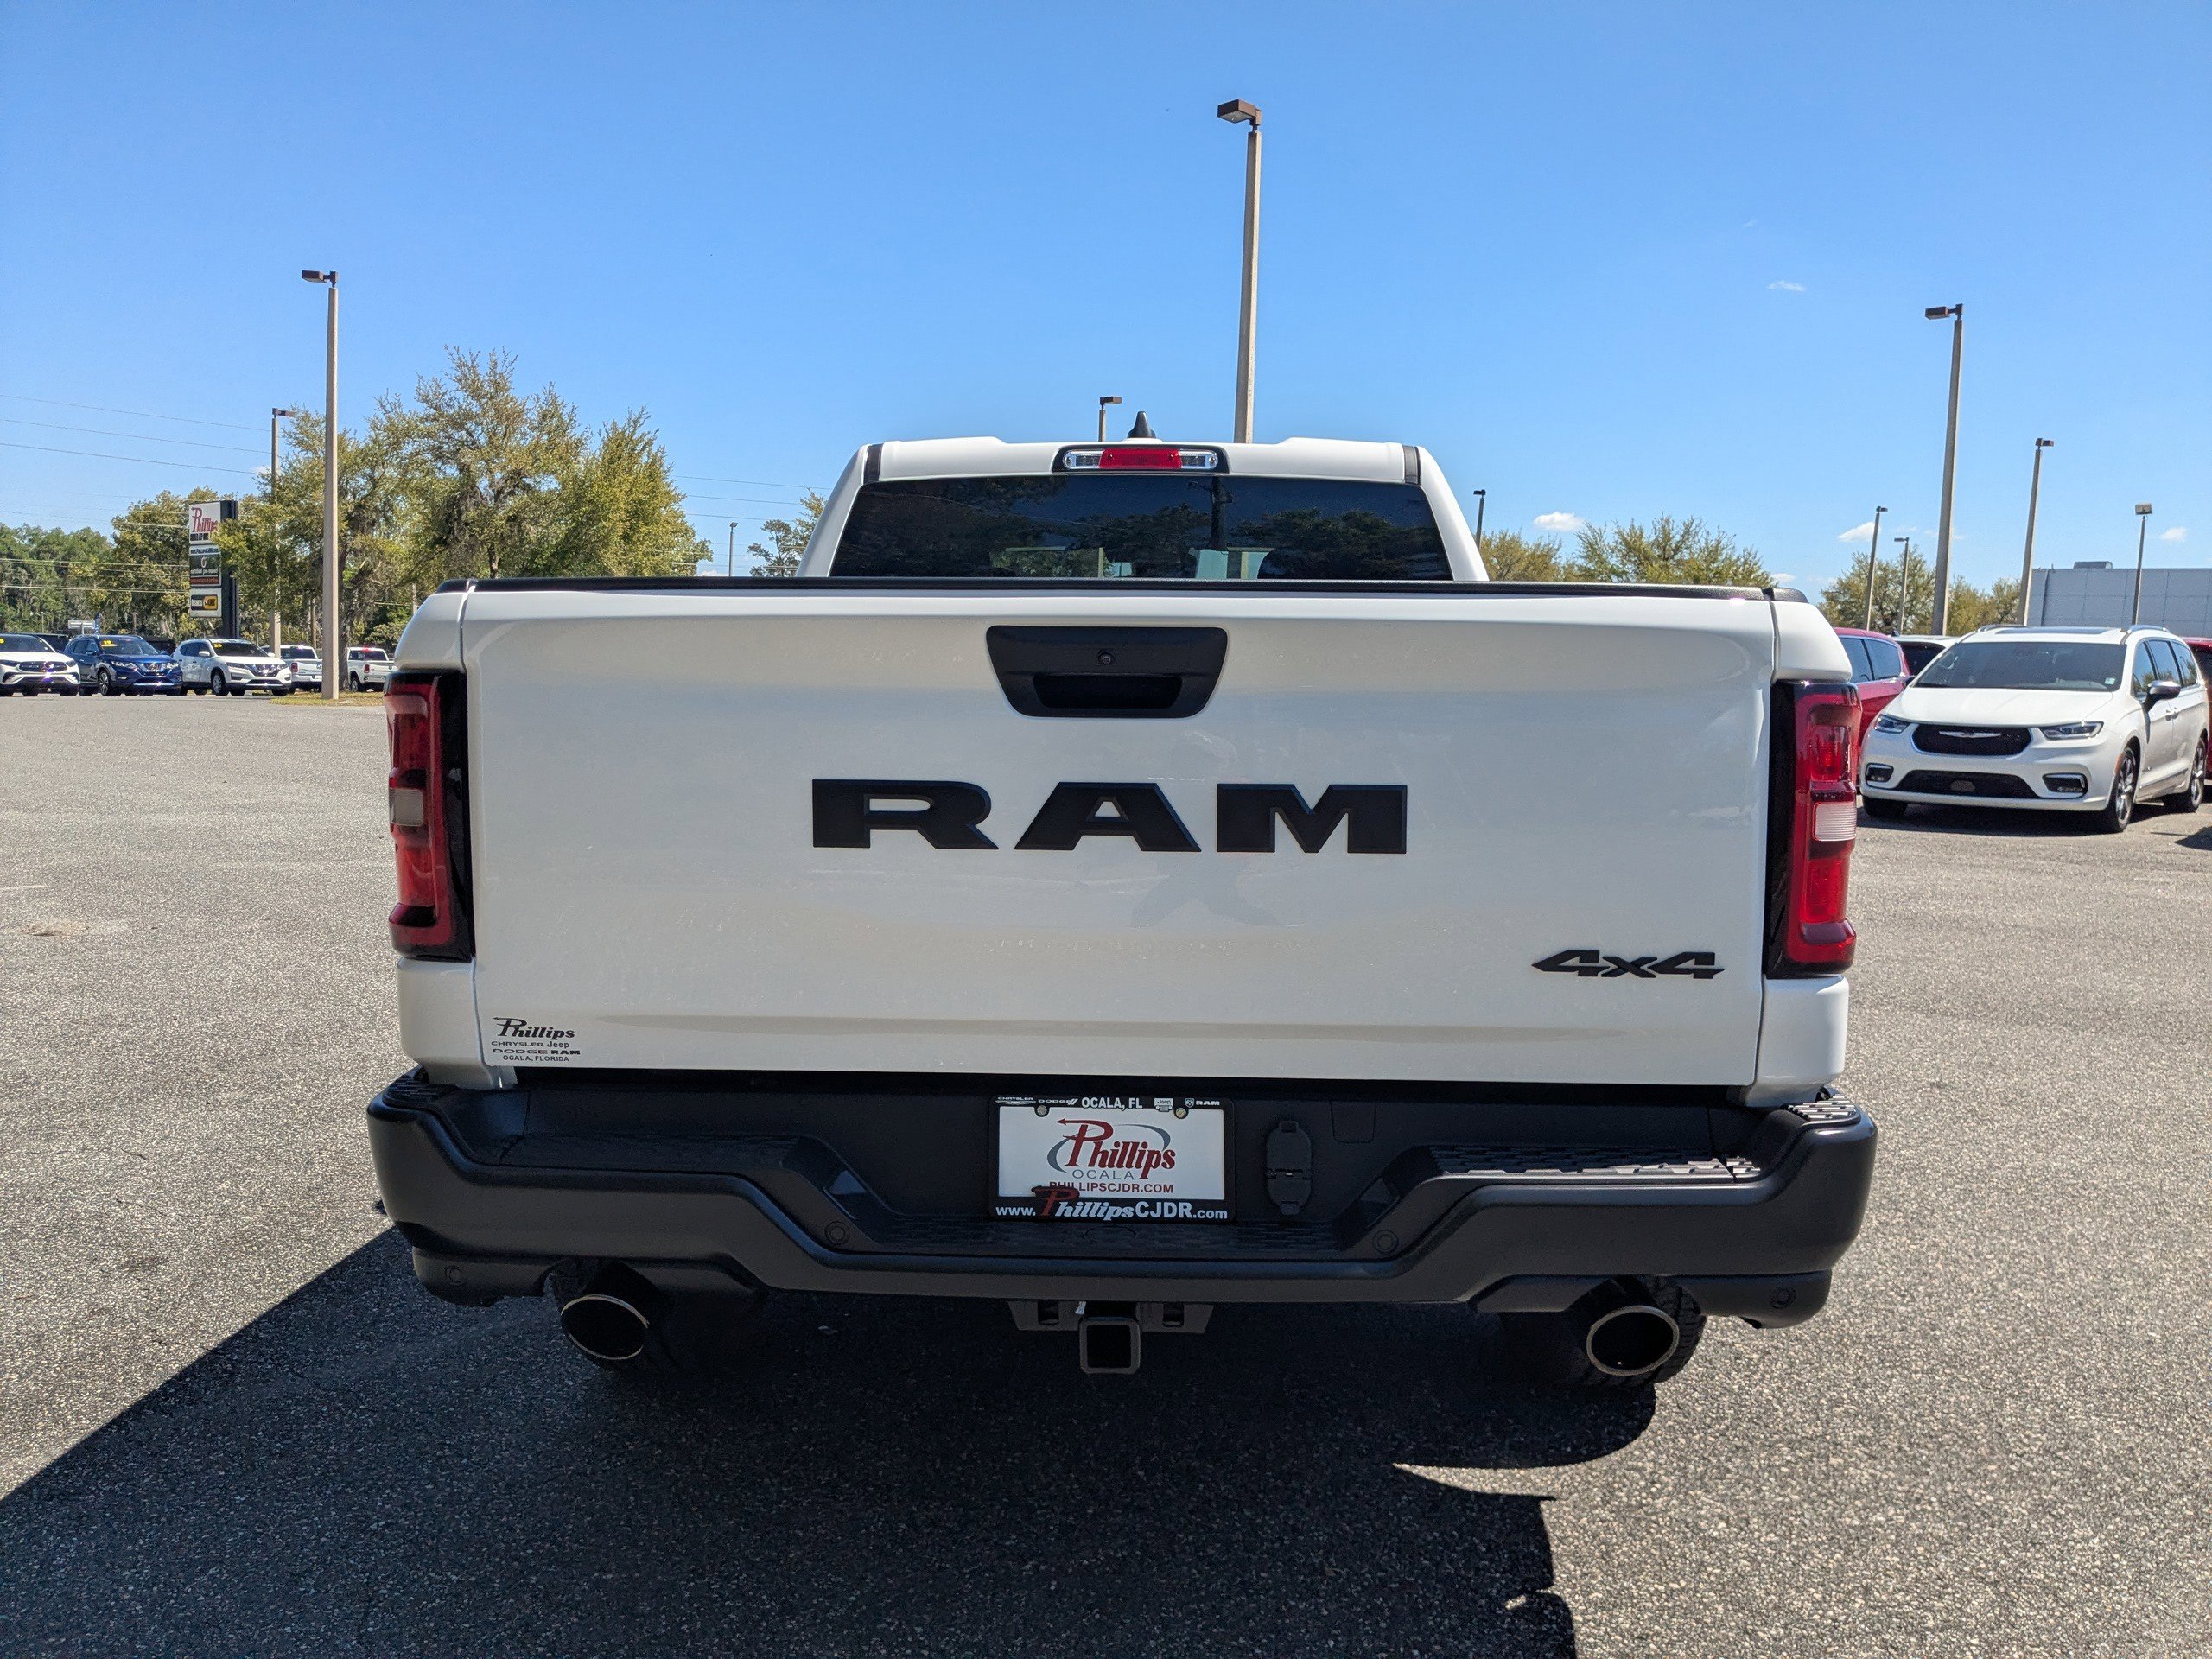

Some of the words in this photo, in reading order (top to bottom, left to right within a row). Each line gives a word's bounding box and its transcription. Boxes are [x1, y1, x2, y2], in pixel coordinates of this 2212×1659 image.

[812, 779, 1408, 854] RAM
[1531, 949, 1726, 980] 4x4
[492, 1017, 575, 1041] Phillips
[547, 1040, 569, 1049] Jeep
[1081, 1096, 1127, 1111] OCALA,
[1128, 1097, 1143, 1109] FL
[1057, 1118, 1177, 1180] Phillips
[1071, 1169, 1135, 1180] OCALA
[995, 1185, 1228, 1221] www.PhillipsCJDR.com
